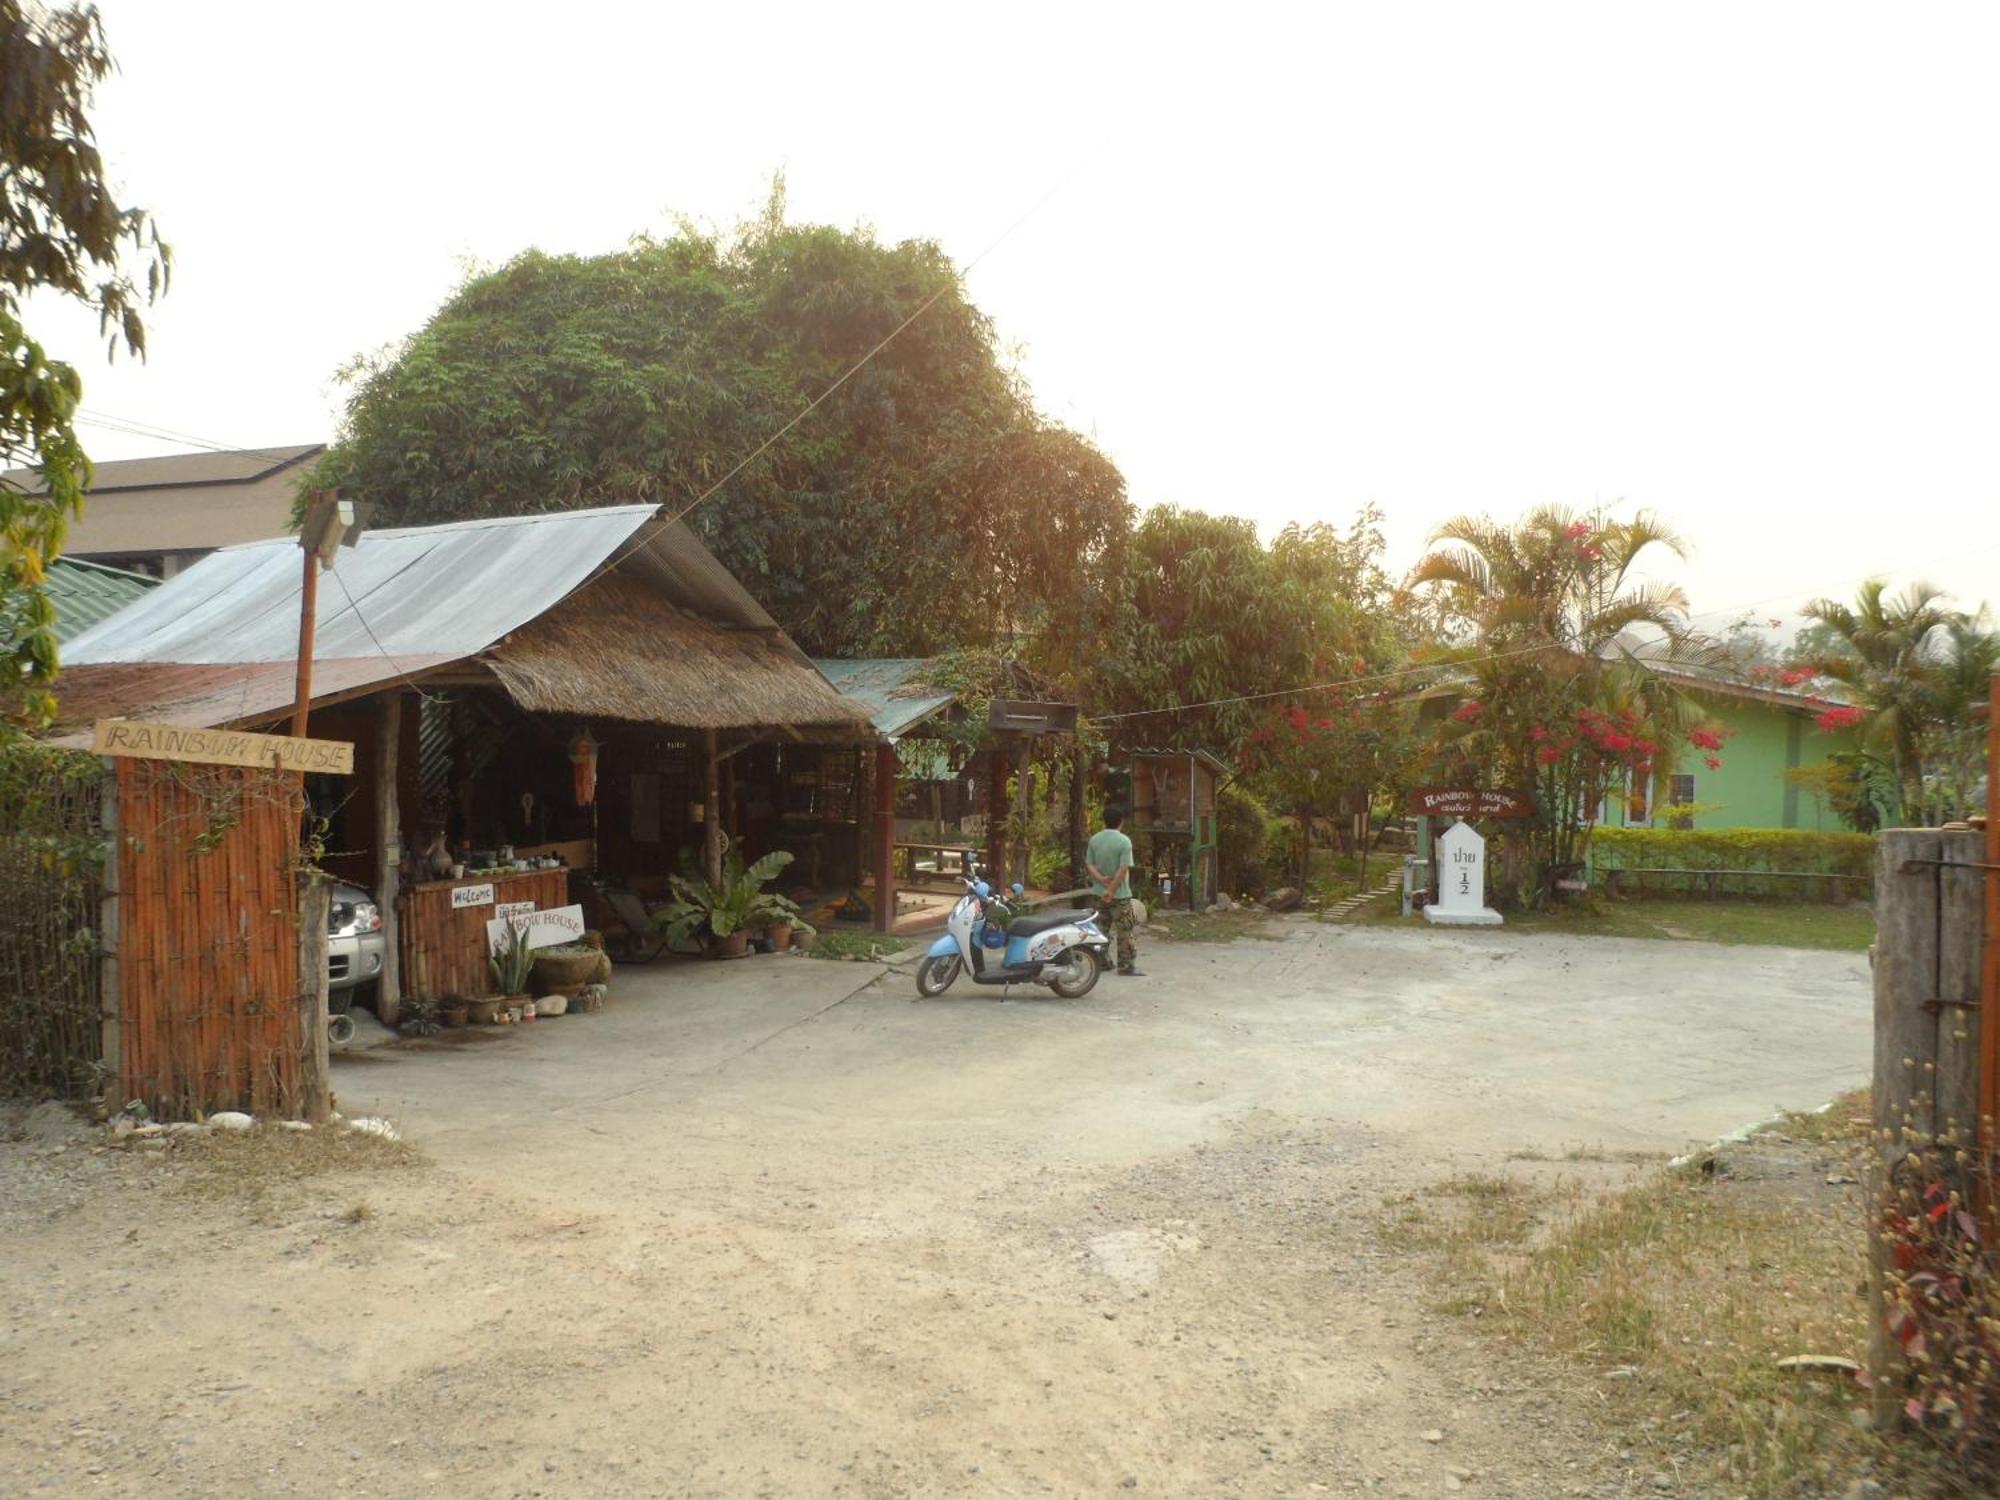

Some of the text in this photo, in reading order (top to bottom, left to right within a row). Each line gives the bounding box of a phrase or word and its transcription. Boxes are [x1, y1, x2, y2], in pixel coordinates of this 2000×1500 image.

[260, 740, 346, 769] HOUSE
[1454, 847, 1476, 863] ปาย
[493, 913, 580, 949] RAIBOW HOUSE
